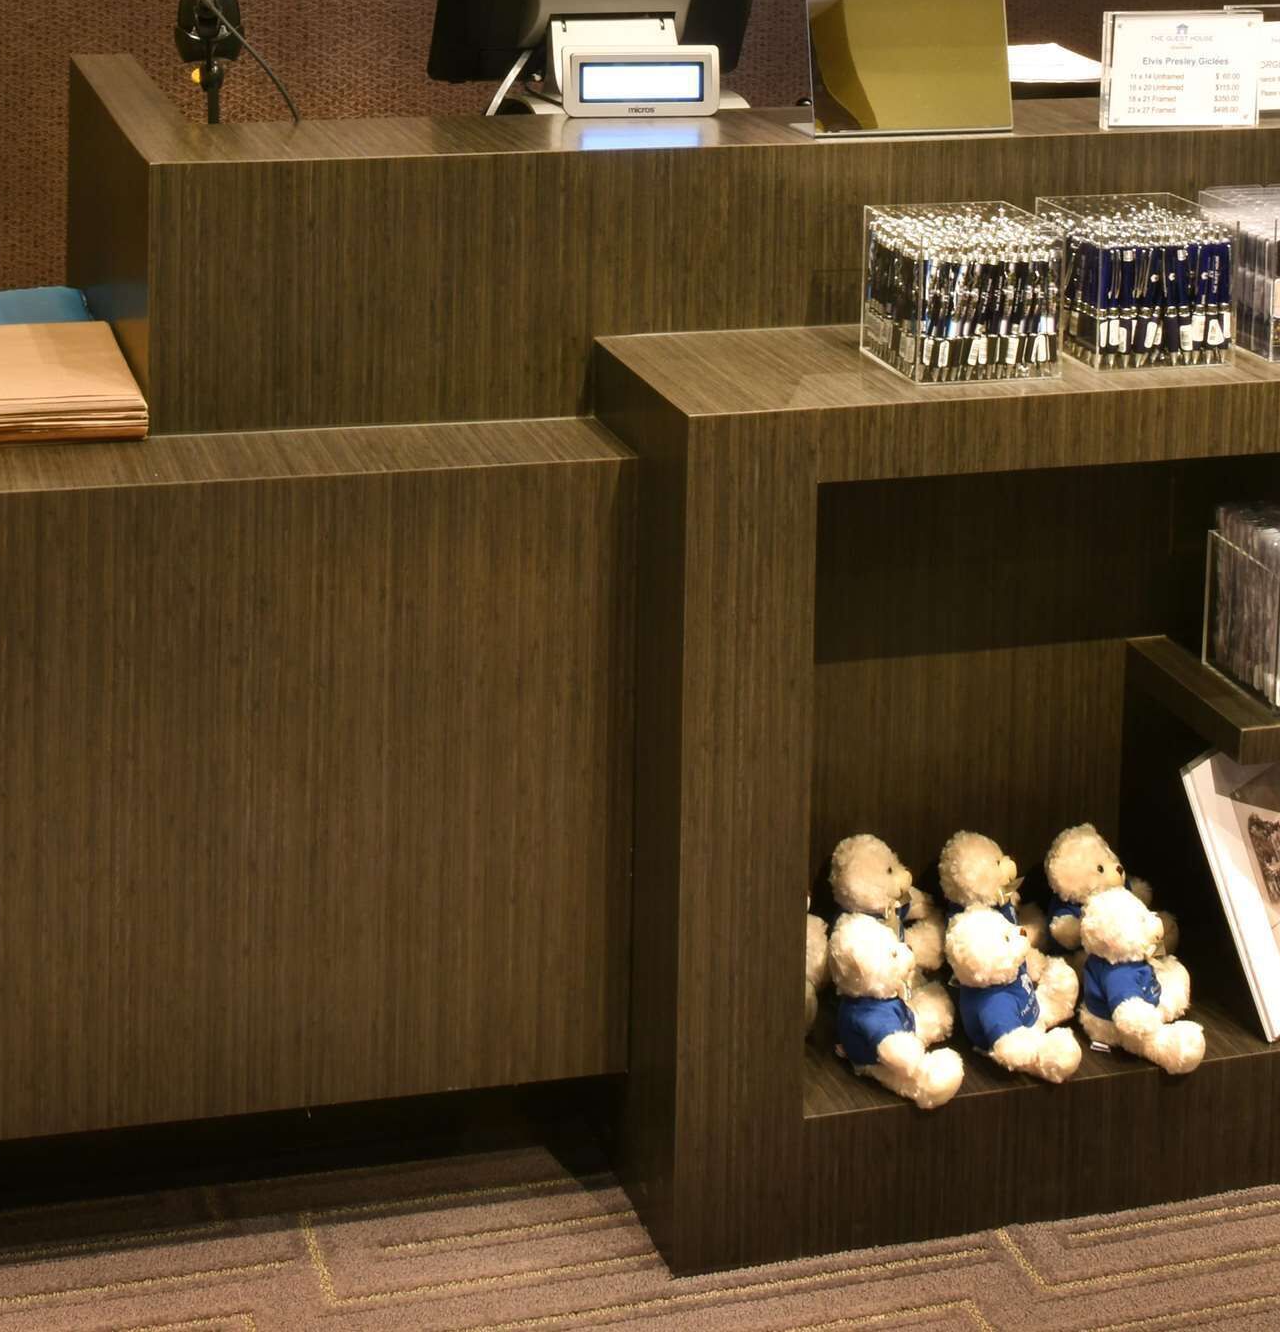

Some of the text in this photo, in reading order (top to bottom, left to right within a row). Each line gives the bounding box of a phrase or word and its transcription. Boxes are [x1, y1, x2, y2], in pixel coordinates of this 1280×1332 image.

[1142, 57, 1163, 66] Elvis
[1165, 57, 1196, 67] Presley
[627, 105, 656, 114] micros
